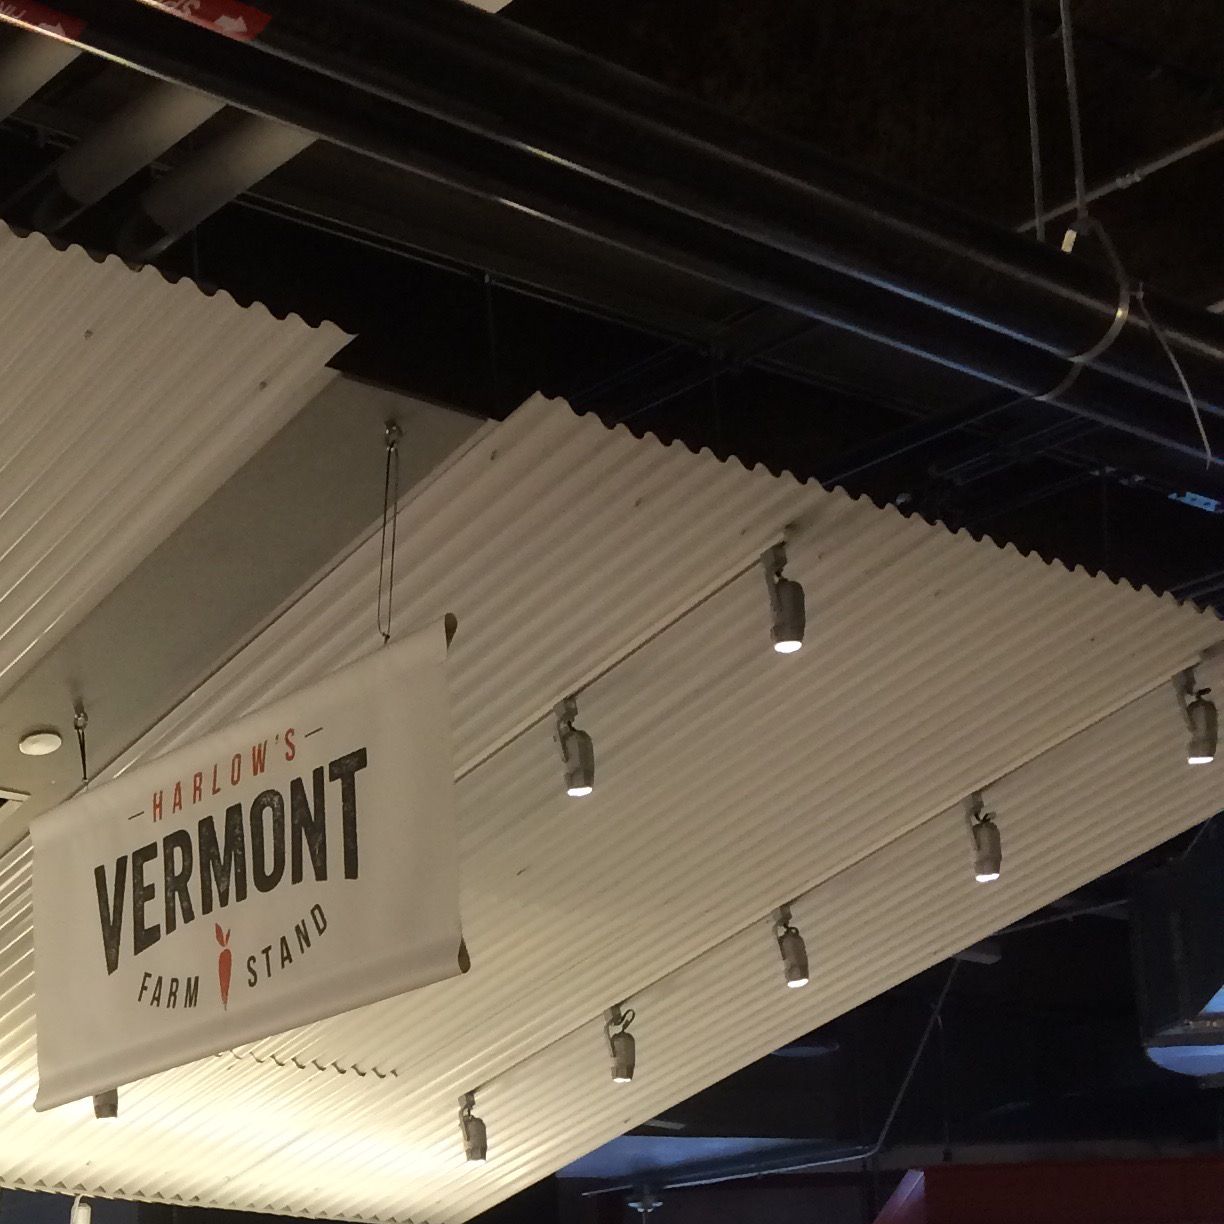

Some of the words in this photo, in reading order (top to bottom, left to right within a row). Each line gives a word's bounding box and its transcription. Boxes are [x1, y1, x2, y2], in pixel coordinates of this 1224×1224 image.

[152, 727, 296, 823] HARLOW'S
[94, 746, 368, 976] VERMONT
[138, 971, 200, 1010] FARM
[247, 902, 329, 988] STAND
